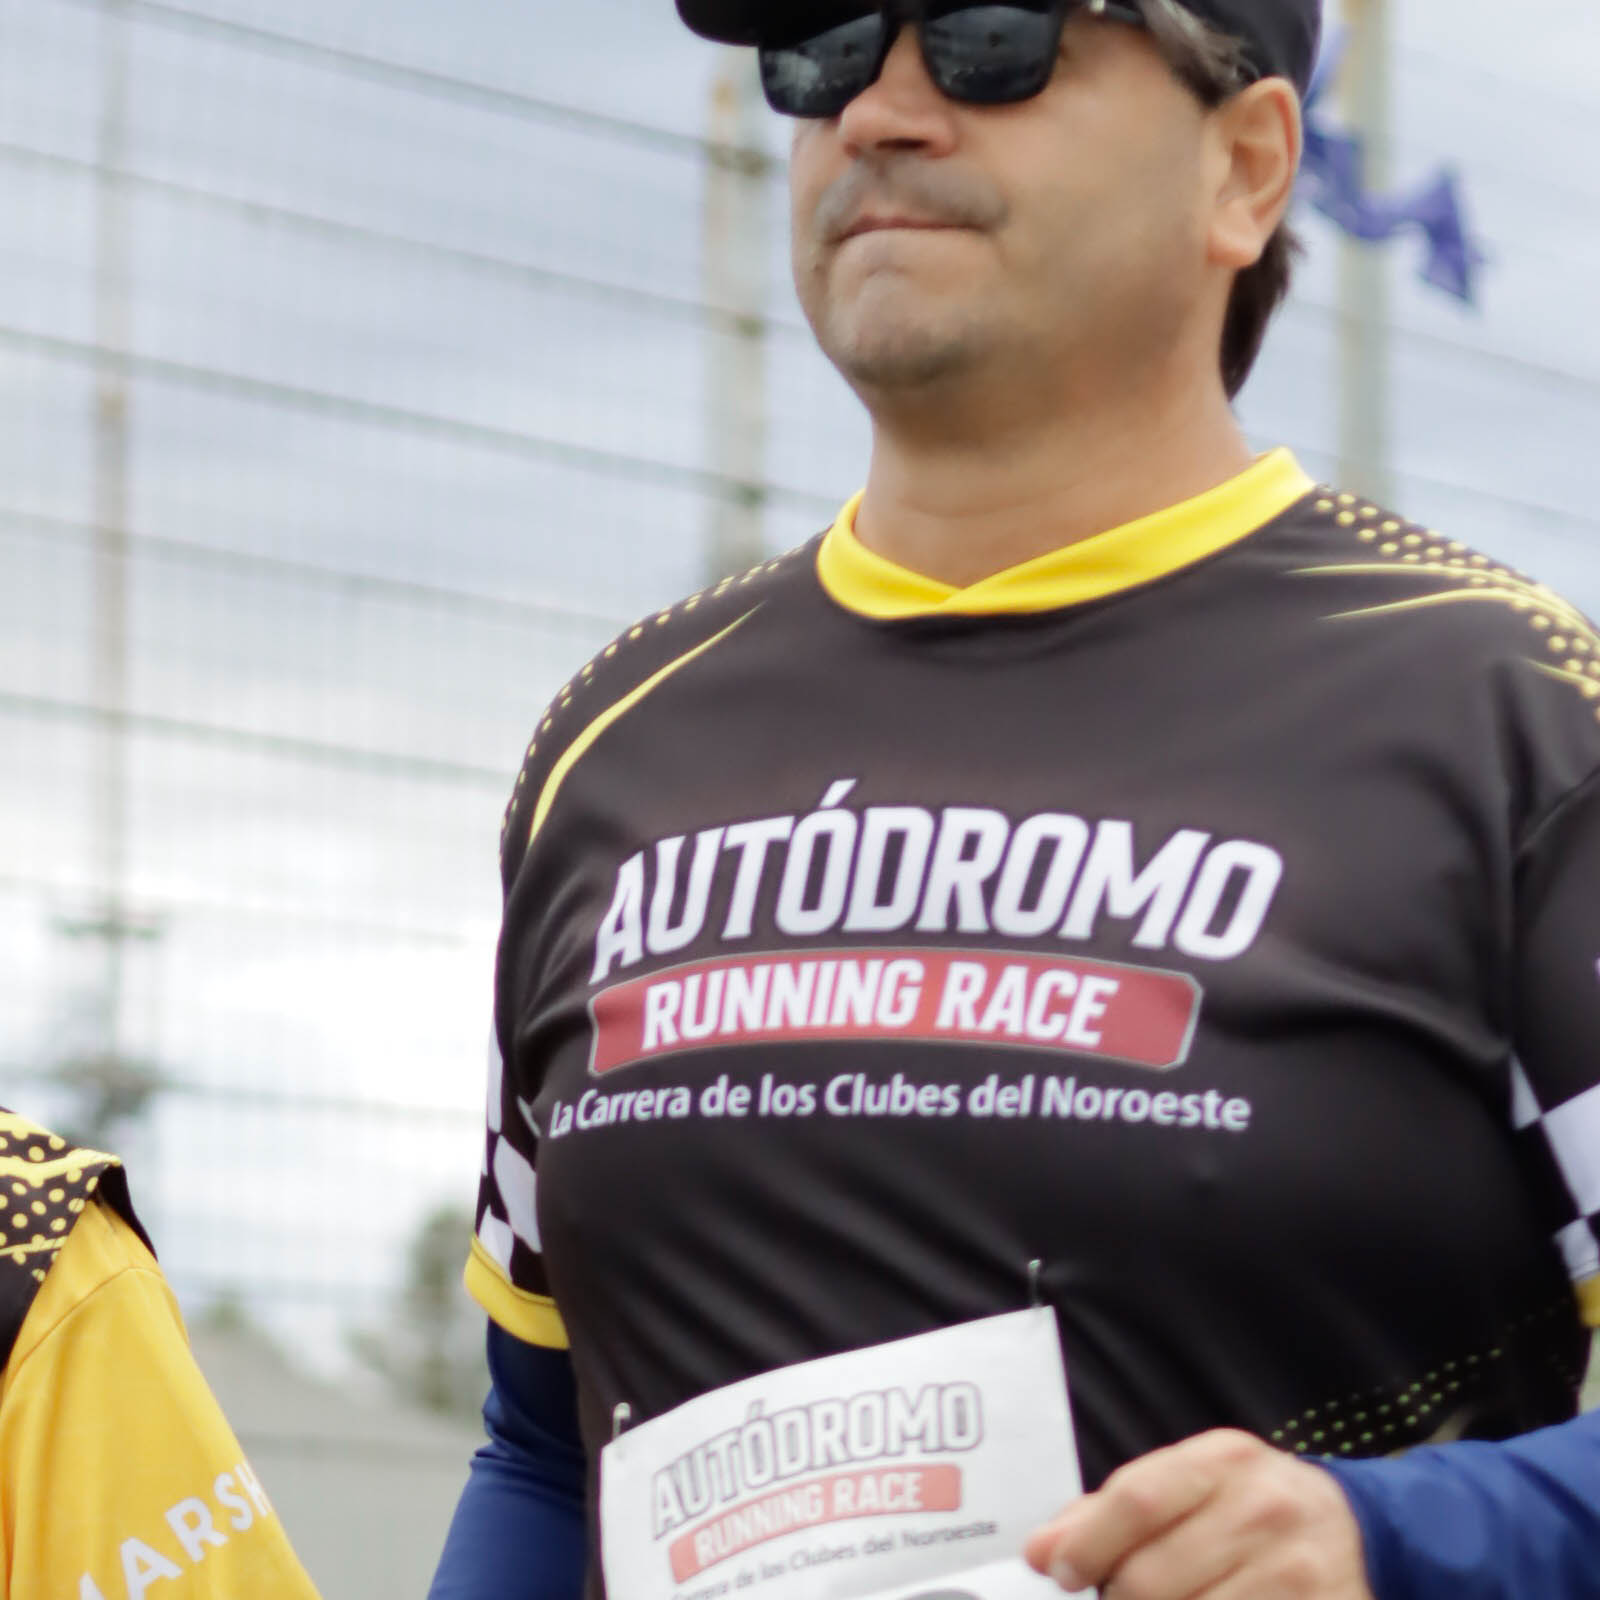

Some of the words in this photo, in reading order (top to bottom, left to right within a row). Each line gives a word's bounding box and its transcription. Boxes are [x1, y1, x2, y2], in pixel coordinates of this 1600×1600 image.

[588, 778, 1283, 984] AUTÓDROMO
[641, 960, 924, 1051] RUNNING
[935, 962, 1119, 1047] RACE
[576, 1086, 691, 1130] Carrera
[700, 1073, 751, 1117] de
[759, 1073, 816, 1117] los
[825, 1073, 960, 1117] Clubes
[968, 1073, 1035, 1117] del
[1040, 1075, 1251, 1131] Noroeste
[652, 1381, 983, 1541] AUTÓDROMO
[693, 1481, 824, 1568] RUNNING
[833, 1471, 923, 1515] RACE
[736, 1571, 754, 1589] de
[761, 1563, 785, 1580] los
[790, 1544, 856, 1571] Clubes
[863, 1534, 895, 1555] del
[901, 1521, 999, 1548] Noroeste
